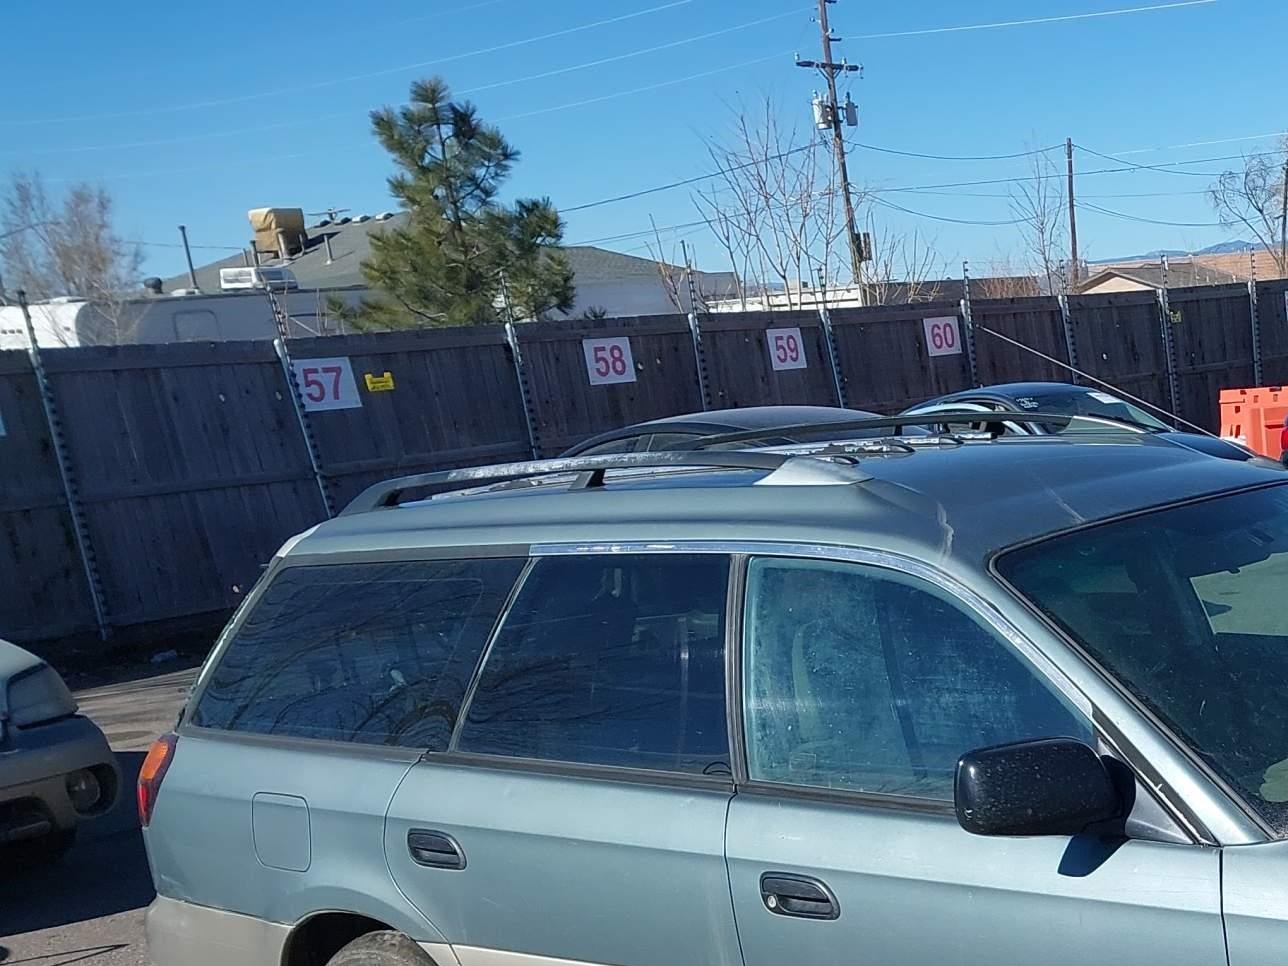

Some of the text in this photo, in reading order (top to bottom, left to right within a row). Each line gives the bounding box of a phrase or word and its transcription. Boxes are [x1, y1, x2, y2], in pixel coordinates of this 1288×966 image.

[774, 334, 799, 363] 59
[931, 323, 955, 349] 60
[594, 345, 626, 377] 58
[303, 366, 342, 402] 57
